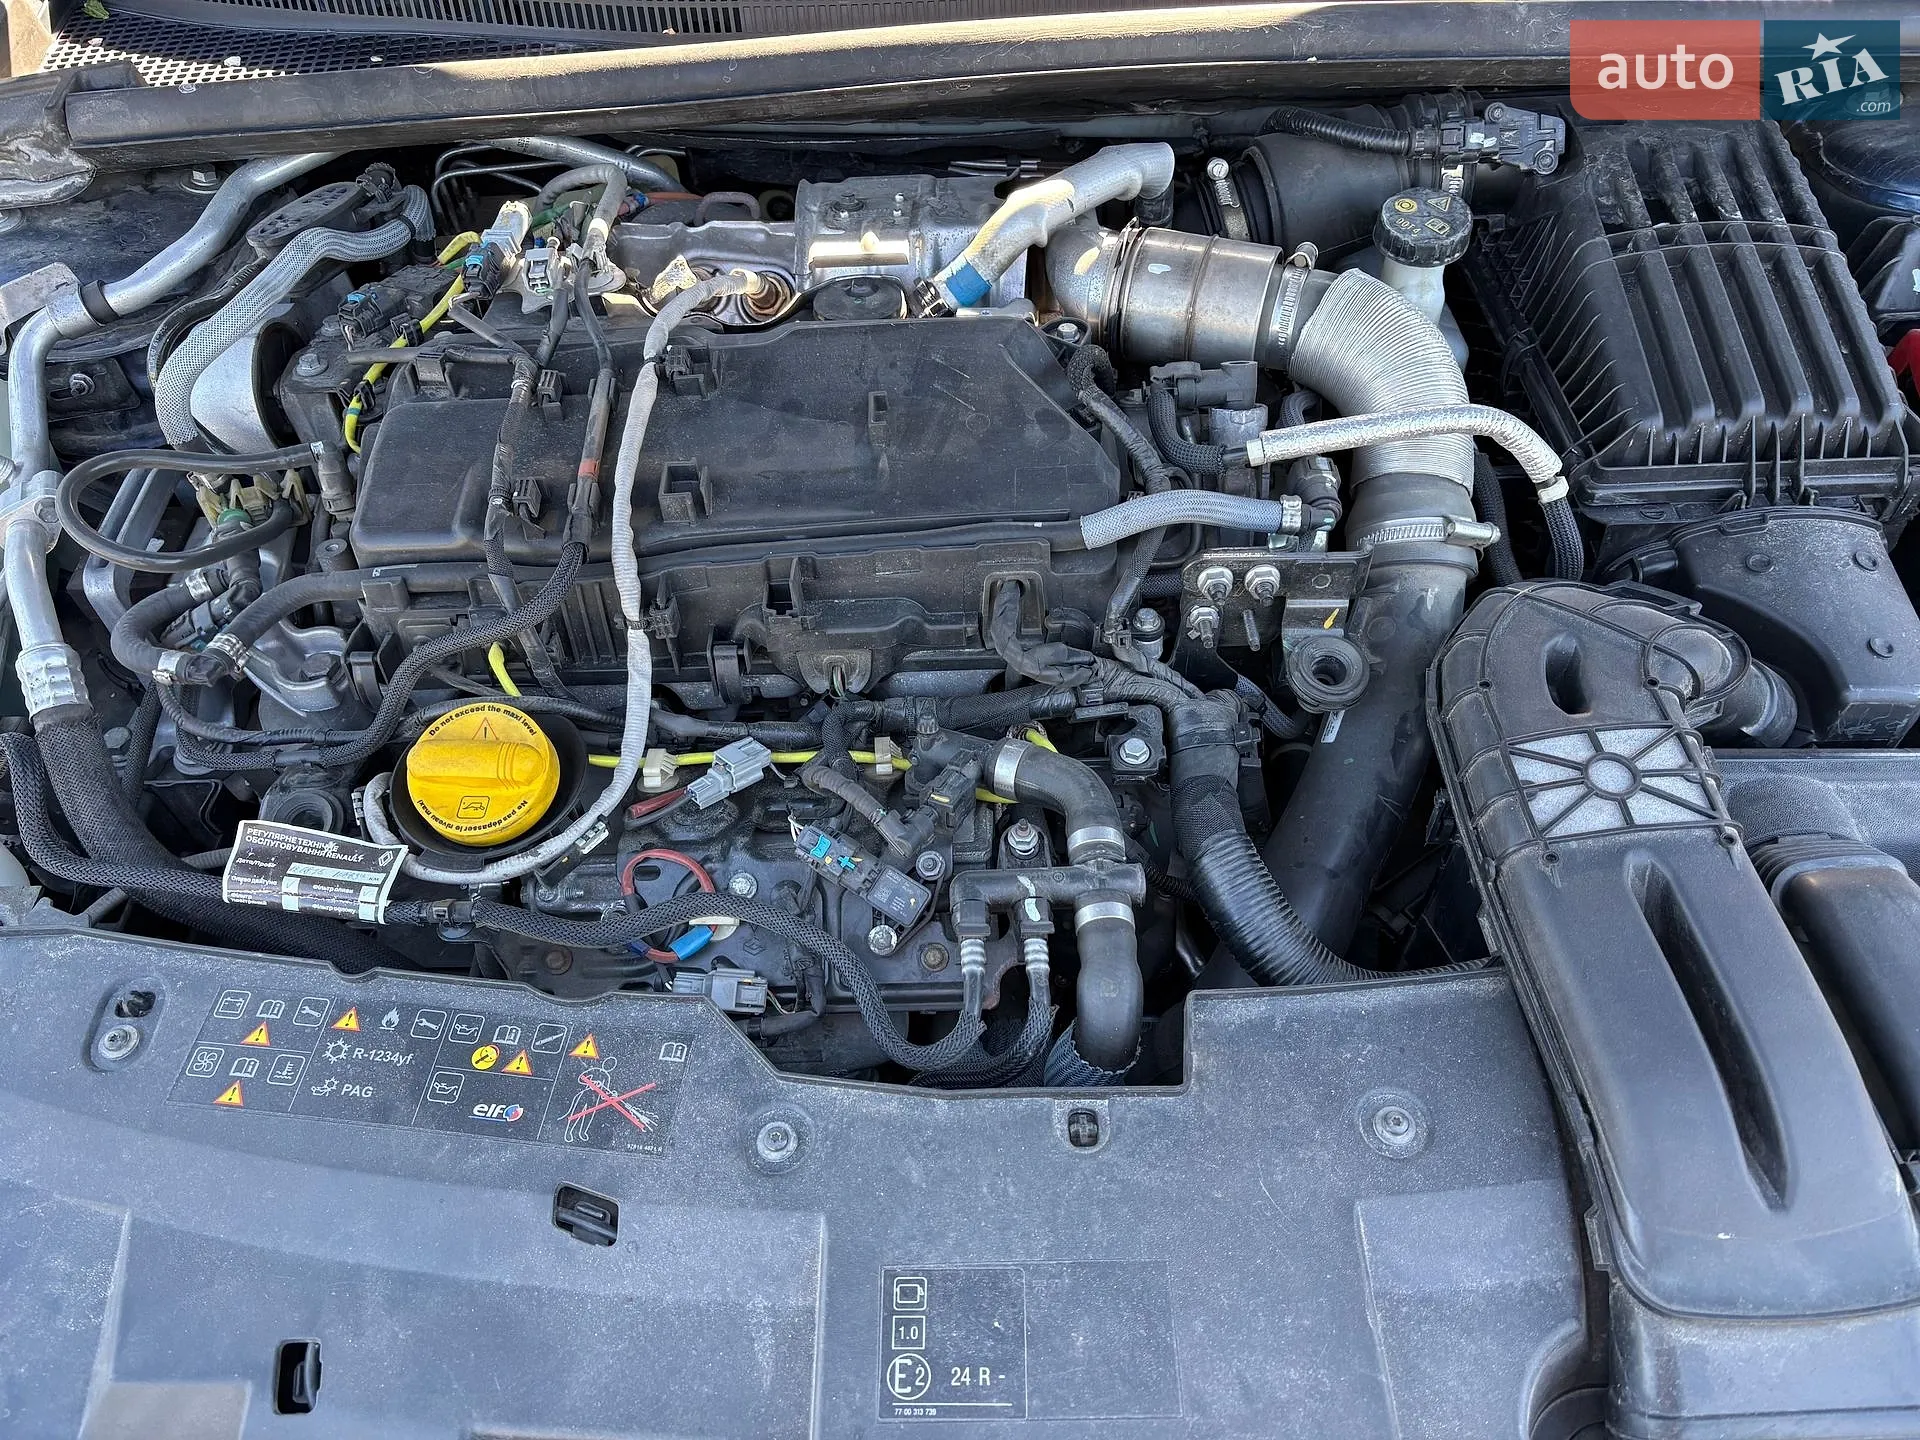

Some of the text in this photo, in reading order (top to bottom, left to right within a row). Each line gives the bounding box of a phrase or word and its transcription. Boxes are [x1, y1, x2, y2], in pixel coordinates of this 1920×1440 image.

[1396, 217, 1415, 230] DOT
[428, 705, 538, 737] Do not exceed the maxi level
[416, 799, 432, 816] maxi
[517, 799, 529, 811] Ne
[429, 812, 455, 831] niveau
[502, 809, 517, 823] pas
[454, 823, 463, 832] le
[247, 827, 340, 852] РЕГУЛЯРНЕ ТЕХНІЧНЕ
[245, 835, 364, 862] ОБСЛУГОВУВАННЯ RENAULT
[352, 1047, 415, 1067] R-1234yf
[341, 1083, 373, 1098] PAG
[472, 1103, 506, 1118] elf
[898, 1326, 919, 1340] 1.0
[951, 1367, 971, 1387] 24
[979, 1367, 991, 1386] R
[894, 1407, 902, 1416] 77
[912, 1407, 924, 1416] 313
